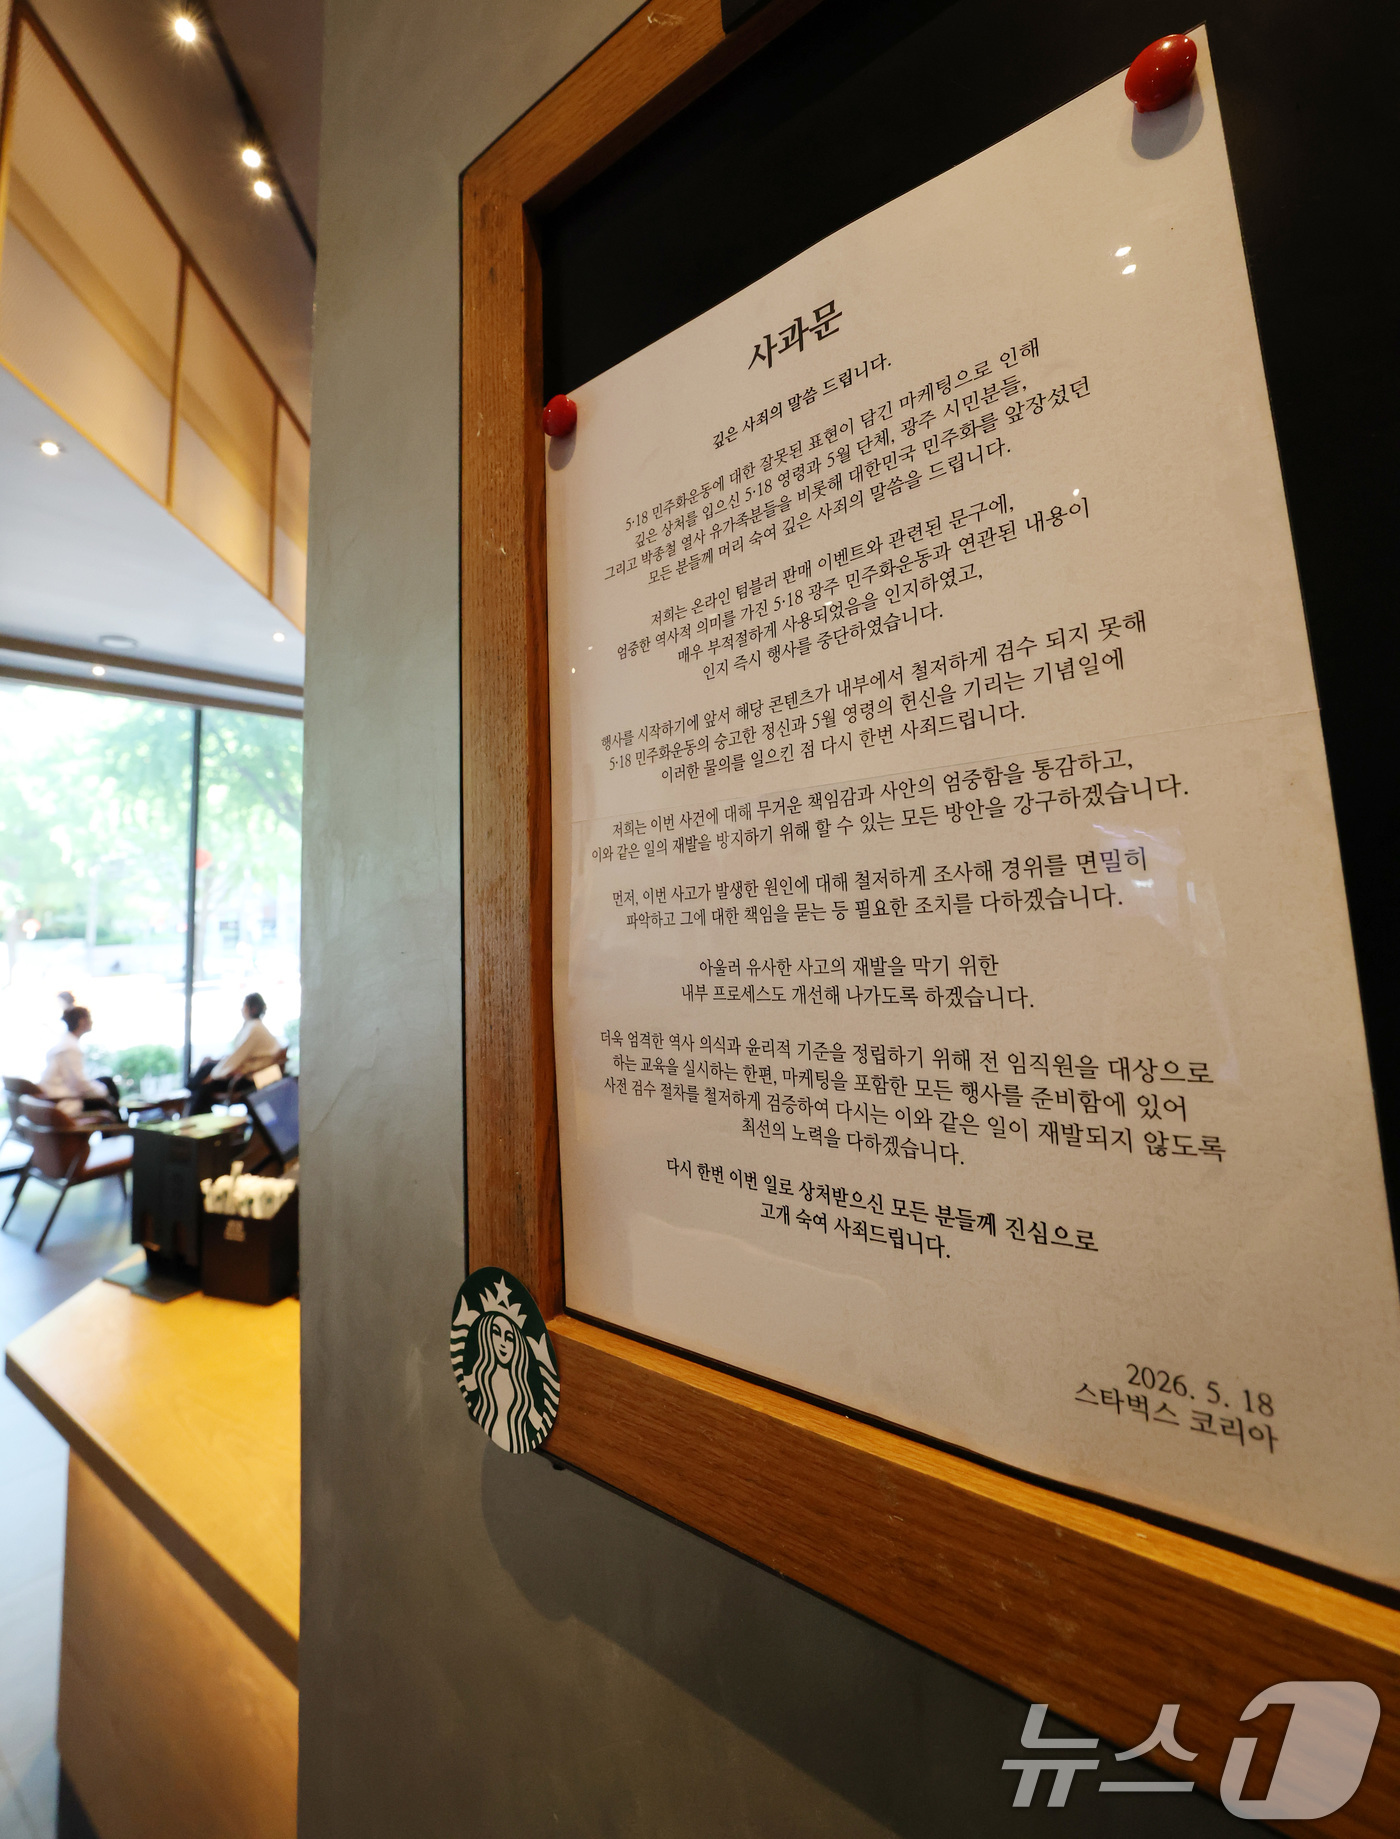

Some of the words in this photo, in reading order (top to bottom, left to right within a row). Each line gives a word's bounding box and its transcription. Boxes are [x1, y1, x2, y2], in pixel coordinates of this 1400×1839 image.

[747, 299, 843, 370] 사과문
[652, 475, 725, 520] 민주화운동에
[729, 461, 756, 485] 대한
[759, 440, 803, 473] 잘못된
[808, 417, 854, 451] 표현이
[860, 400, 893, 429] 담긴
[899, 360, 993, 410] 마케팅으로
[999, 337, 1040, 369] 인해
[712, 426, 739, 450] 깊은
[742, 401, 783, 433] 사죄의
[787, 386, 818, 413] 말씀
[822, 352, 892, 396] 드립니다.
[604, 557, 638, 580] 그리고
[641, 540, 676, 565] 박종철
[681, 528, 706, 551] 열사
[709, 494, 792, 540] 유가족분들을
[797, 472, 843, 503] 비롯해
[848, 444, 917, 483] 대한민국
[922, 411, 999, 455] 민주화를
[1005, 375, 1091, 425] 앞장섰던
[635, 528, 658, 549] 깊은
[661, 510, 698, 537] 상처를
[702, 491, 740, 521] 입으신
[777, 456, 822, 488] 영령과
[827, 444, 851, 468] 5월
[856, 427, 895, 456] 단체,
[900, 409, 937, 437] 광주
[943, 374, 1027, 418] 시민분들,
[651, 605, 688, 626] 저희는
[691, 587, 731, 615] 온라인
[735, 571, 777, 600] 텀블러
[782, 559, 812, 585] 판매
[817, 535, 884, 571] 이벤트와
[888, 515, 943, 550] 관련된
[948, 493, 1014, 530] 문구에,
[677, 643, 704, 663] 매우
[707, 620, 777, 656] 부적절하게
[782, 591, 879, 633] 사용되었음을
[884, 563, 983, 605] 인지하였고,
[601, 729, 634, 751] 행사를
[637, 713, 699, 742] 시작하기에
[703, 706, 730, 729] 앞서
[735, 698, 764, 720] 해당
[768, 683, 831, 714] 콘텐츠가
[836, 665, 903, 698] 내부에서
[911, 645, 987, 682] 철저하게
[996, 636, 1038, 663] 검수
[1045, 622, 1089, 650] 되지
[1097, 609, 1146, 642] 못해
[661, 761, 700, 784] 이러한
[703, 753, 746, 777] 물의를
[750, 743, 794, 769] 일으킨
[800, 739, 814, 760] 점
[821, 731, 852, 755] 다시
[859, 724, 894, 749] 한번
[900, 700, 1025, 740] 사죄드립니다.
[592, 845, 614, 863] 이와
[617, 842, 640, 861] 같은
[644, 838, 668, 858] 일의
[672, 833, 712, 854] 재발을
[716, 825, 773, 850] 방지하기
[779, 820, 810, 842] 위해
[814, 817, 832, 839] 할
[836, 815, 854, 836] 수
[860, 811, 895, 834] 있는
[901, 805, 939, 827] 모든
[944, 796, 1007, 824] 방안을
[1013, 773, 1189, 816] 강구하겠습니다.
[613, 819, 647, 838] 저희는
[650, 813, 675, 833] 이번
[679, 807, 719, 829] 사건에
[724, 802, 752, 823] 대해
[756, 795, 803, 819] 무거운
[807, 784, 875, 811] 책임감과
[880, 774, 935, 801] 사안의
[943, 762, 1025, 794] 엄중함을
[1031, 749, 1133, 781] 통감하고,
[612, 889, 639, 907] 먼저,
[642, 886, 667, 905] 이번
[671, 882, 712, 903] 사고가
[715, 878, 759, 901] 발생한
[763, 874, 809, 897] 원인에
[815, 871, 848, 894] 대해
[854, 864, 926, 891] 철저하게
[933, 859, 993, 884] 조사해
[1001, 853, 1068, 881] 경위를
[1075, 846, 1147, 875] 면밀히
[626, 910, 676, 930] 파악하고
[680, 908, 706, 927] 그에
[711, 906, 740, 926] 대한
[744, 903, 790, 924] 책임을
[793, 902, 827, 922] 묻는
[831, 900, 849, 921] 등
[854, 896, 909, 920] 필요한
[915, 892, 974, 916] 조치를
[980, 882, 1123, 914] 다하겠습니다.
[681, 983, 709, 1003] 내부
[712, 984, 787, 1004] 프로세스도
[792, 984, 840, 1006] 개선해
[846, 984, 919, 1007] 나가도록
[924, 985, 1034, 1010] 하겠습니다.
[699, 957, 741, 977] 아울러
[746, 957, 793, 977] 유사한
[796, 956, 846, 977] 사고의
[852, 955, 907, 977] 재발을
[911, 954, 949, 977] 막기
[958, 953, 999, 977] 위한
[600, 1029, 624, 1048] 더욱
[627, 1030, 665, 1050] 엄격한
[668, 1033, 695, 1053] 역사
[699, 1034, 742, 1056] 의식과
[745, 1037, 791, 1060] 윤리적
[797, 1040, 847, 1063] 기준을
[852, 1043, 923, 1069] 정립하기
[932, 1047, 971, 1072] 위해
[979, 1049, 999, 1073] 전
[1007, 1051, 1099, 1080] 임직원을
[1107, 1056, 1214, 1084] 대상으로
[612, 1053, 637, 1072] 하는
[640, 1056, 679, 1076] 교육을
[683, 1059, 739, 1082] 실시하는
[742, 1063, 777, 1087] 한편,
[782, 1066, 848, 1092] 마케팅을
[853, 1073, 908, 1097] 포함한
[914, 1078, 954, 1102] 모든
[959, 1080, 1024, 1108] 행사를
[1030, 1087, 1126, 1118] 준비함에
[1137, 1093, 1187, 1123] 있어
[742, 1117, 786, 1142] 최선의
[791, 1124, 841, 1149] 노력을
[846, 1130, 965, 1166] 다하겠습니다.
[666, 1157, 692, 1179] 다시
[696, 1162, 725, 1185] 한번
[729, 1168, 758, 1191] 이번
[763, 1174, 795, 1196] 일로
[798, 1180, 885, 1216] 상처받으신
[890, 1198, 929, 1224] 모든
[934, 1204, 996, 1238] 분들께
[1005, 1216, 1099, 1252] 진심으로
[760, 1202, 790, 1226] 고개
[795, 1208, 827, 1235] 숙여
[833, 1216, 951, 1259] 사죄드립니다.
[1074, 1382, 1180, 1426] 스타벅스
[1190, 1410, 1279, 1454] 코리아
[1126, 1363, 1195, 1400] 2026.
[1206, 1380, 1229, 1408] 5.
[1243, 1389, 1274, 1417] 18
